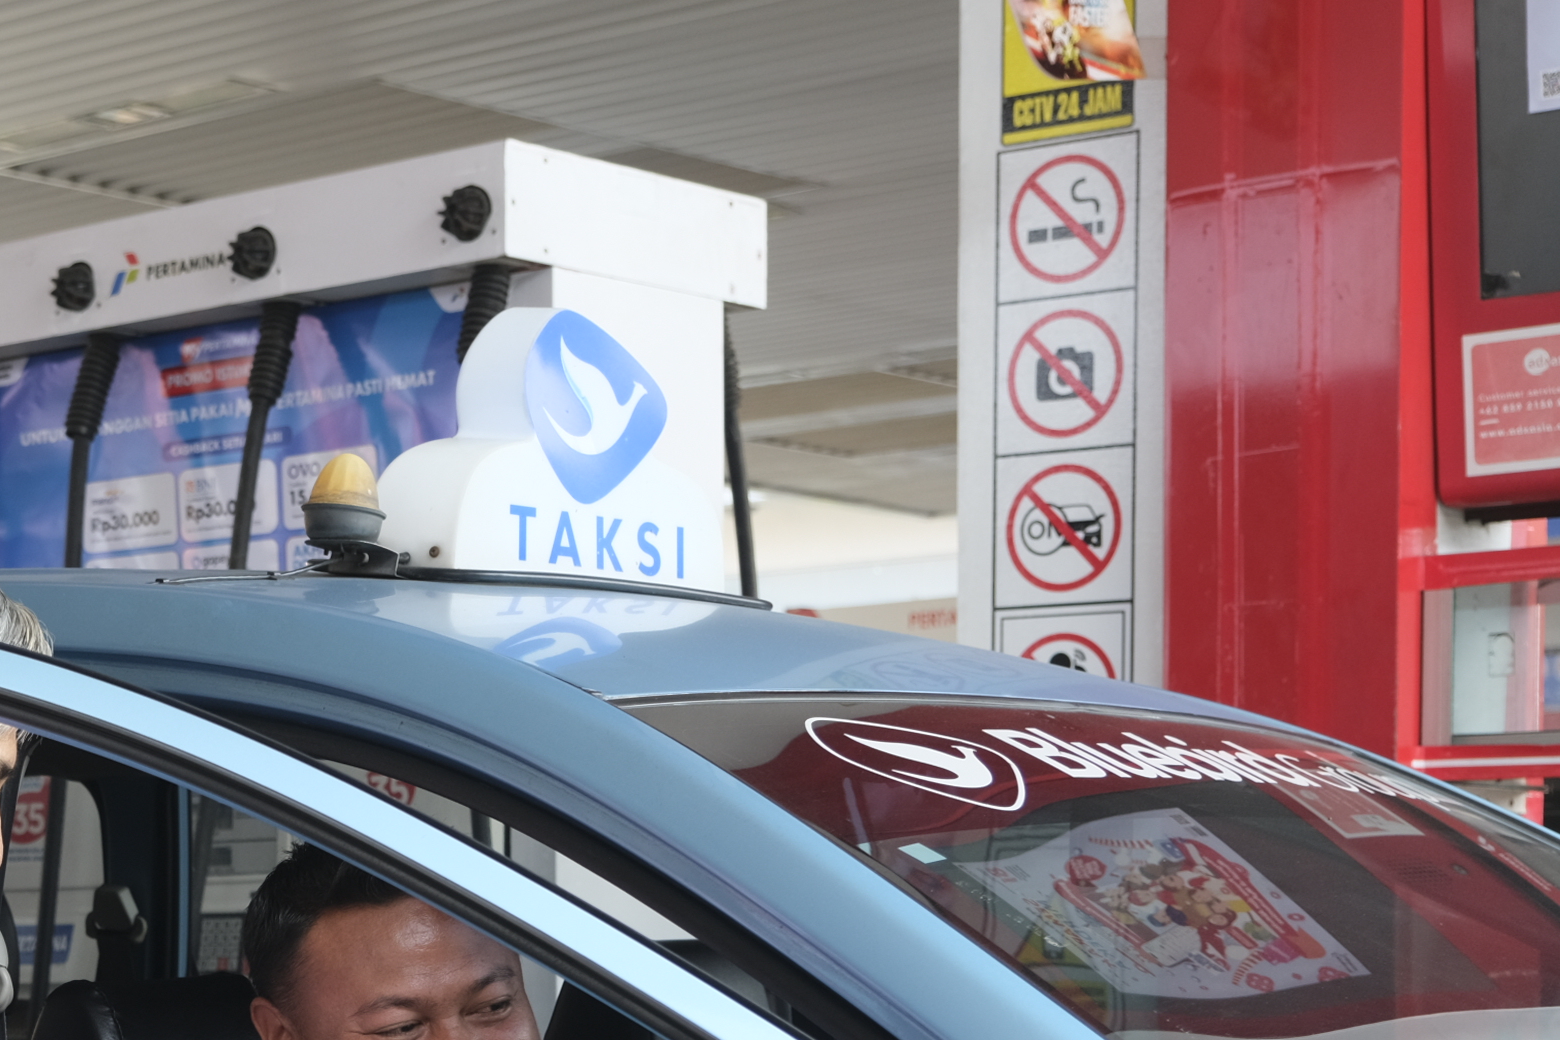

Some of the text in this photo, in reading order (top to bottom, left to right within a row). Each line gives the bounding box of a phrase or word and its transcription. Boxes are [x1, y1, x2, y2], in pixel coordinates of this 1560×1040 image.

[1012, 82, 1123, 127] CCTV 24 JAM
[145, 252, 228, 280] PERTAMINA
[287, 461, 320, 479] OVO
[91, 509, 160, 536] Rp30.000
[186, 498, 239, 525] Rp30.0
[509, 504, 685, 580] TAKSI
[982, 727, 1322, 787] Bluebird
